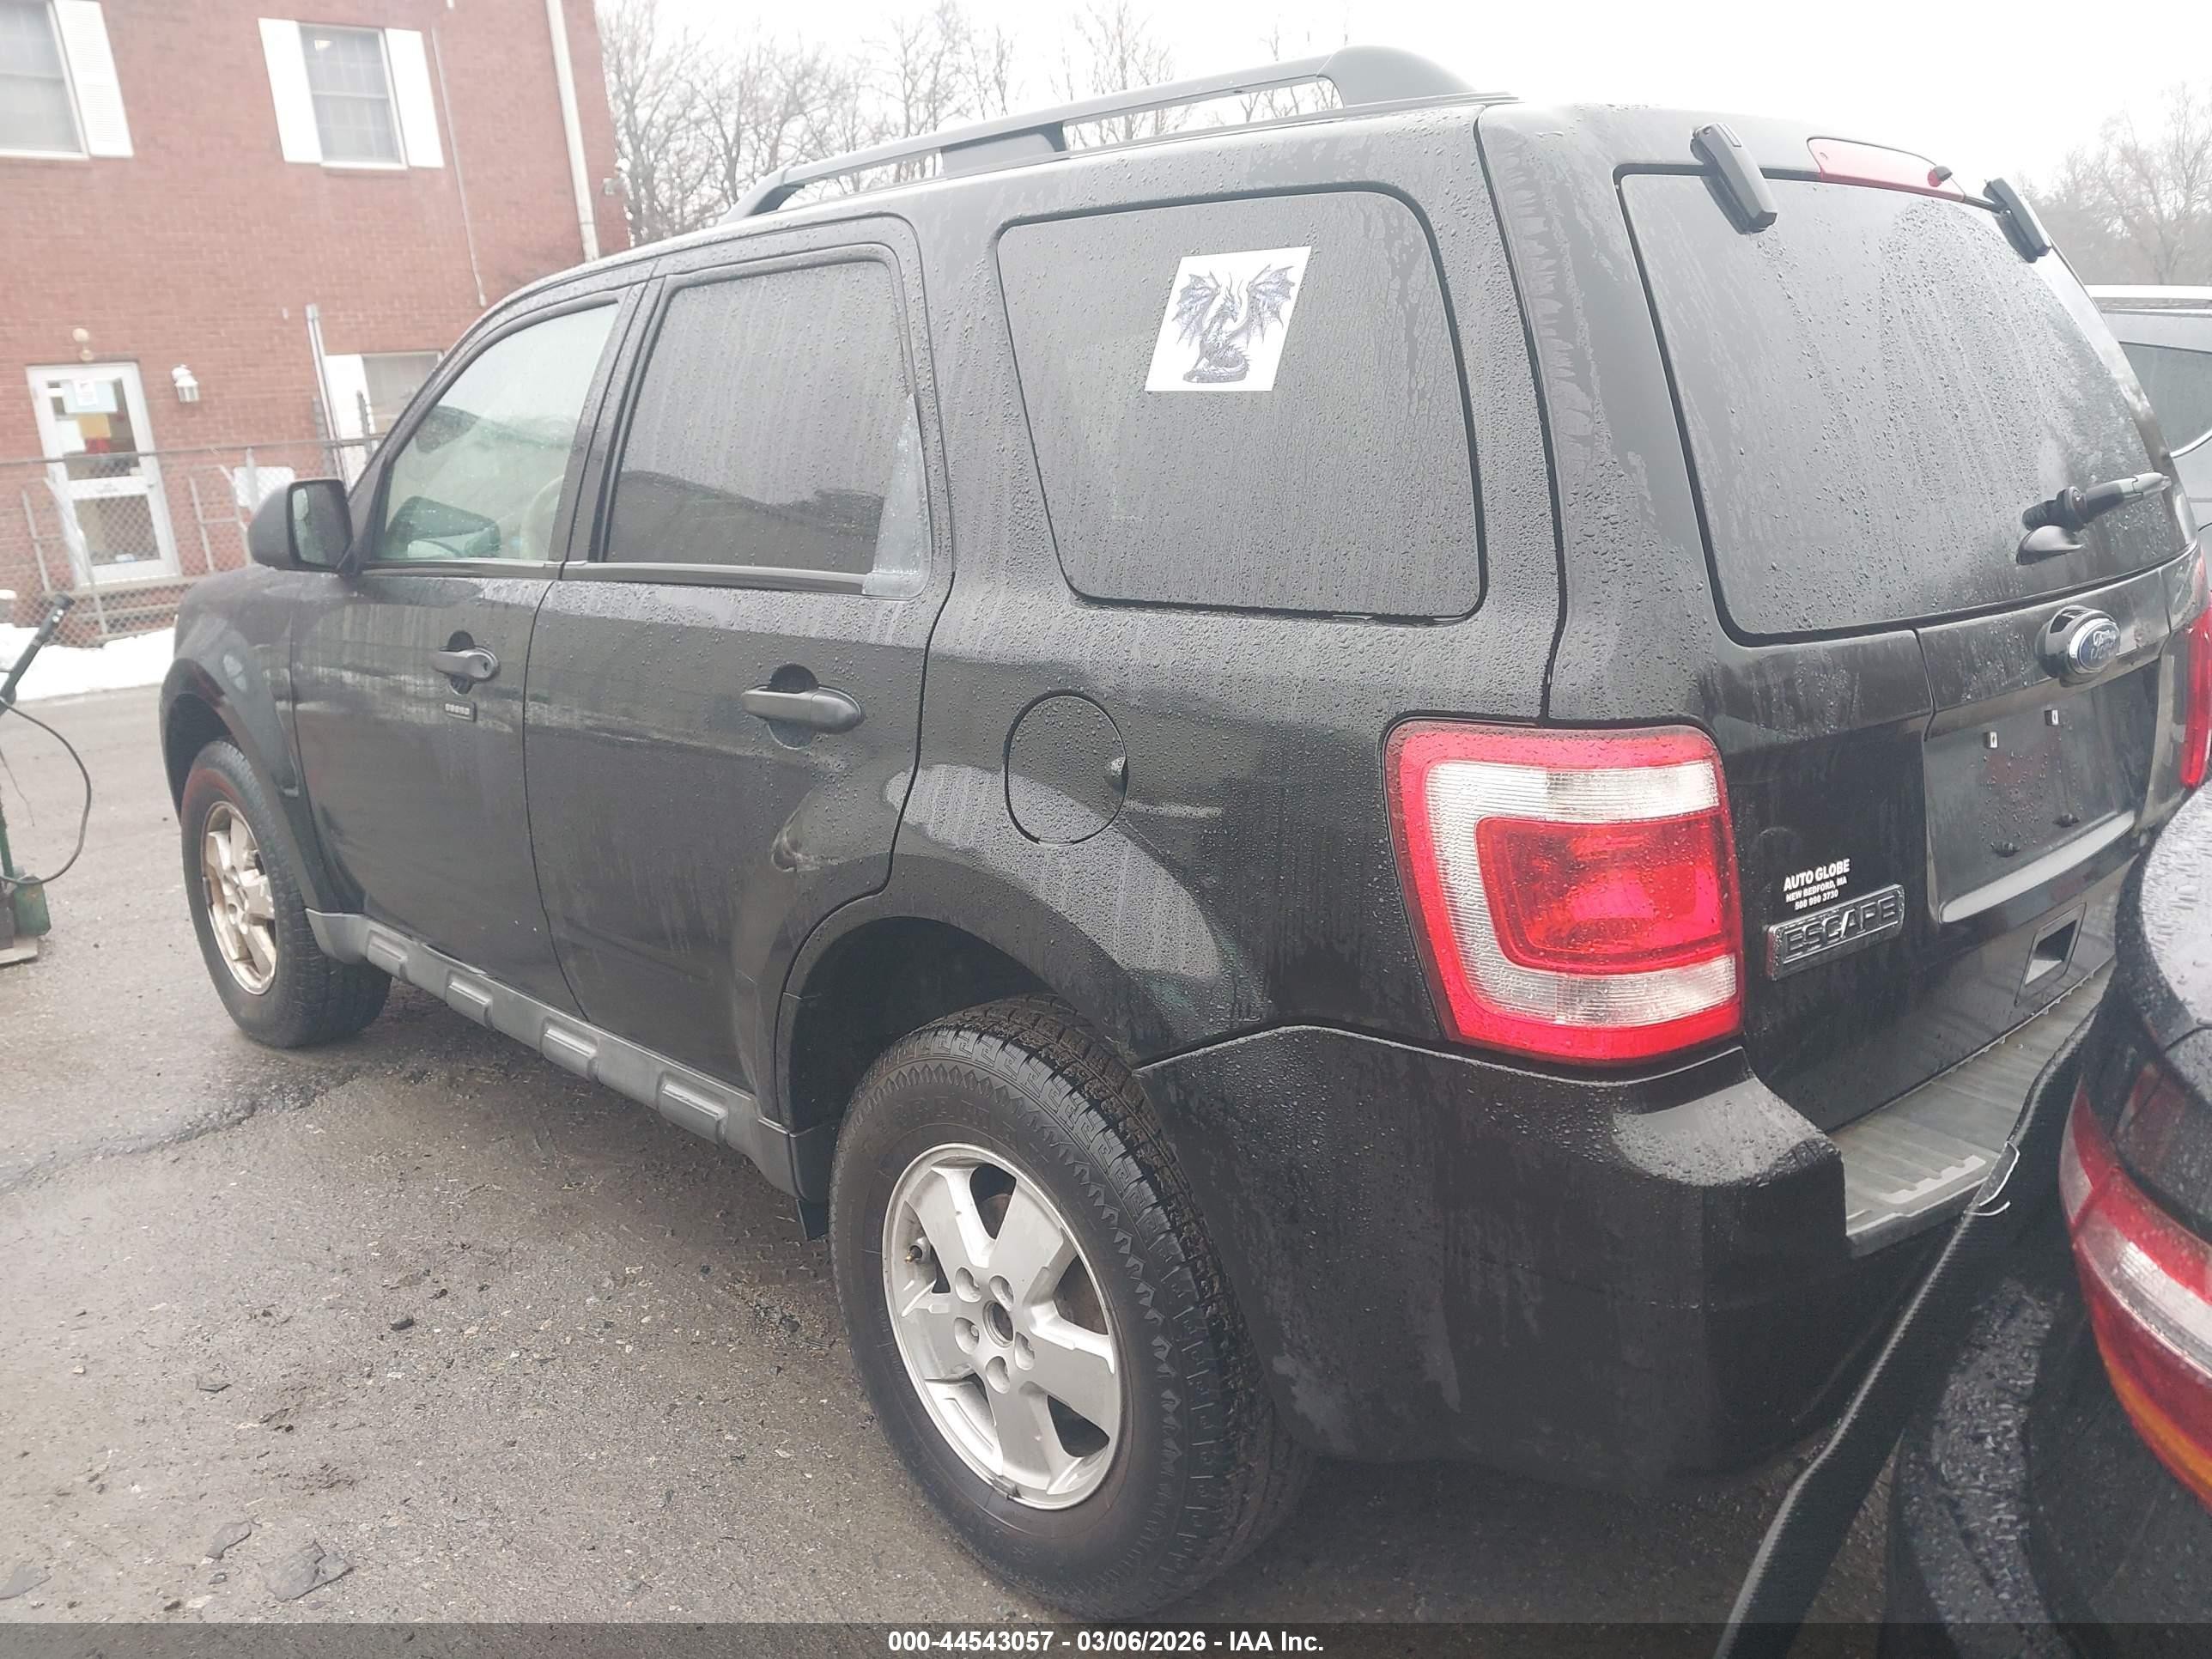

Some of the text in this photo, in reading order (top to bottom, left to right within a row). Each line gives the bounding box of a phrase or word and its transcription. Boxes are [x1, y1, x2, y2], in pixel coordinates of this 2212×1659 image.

[1784, 859, 1850, 892] AUTO GLOBE
[1785, 890, 1803, 902] NEW
[1803, 880, 1836, 898] BEDFORD,
[1822, 889, 1839, 902] 3730
[1783, 895, 1896, 960] ESCAPE
